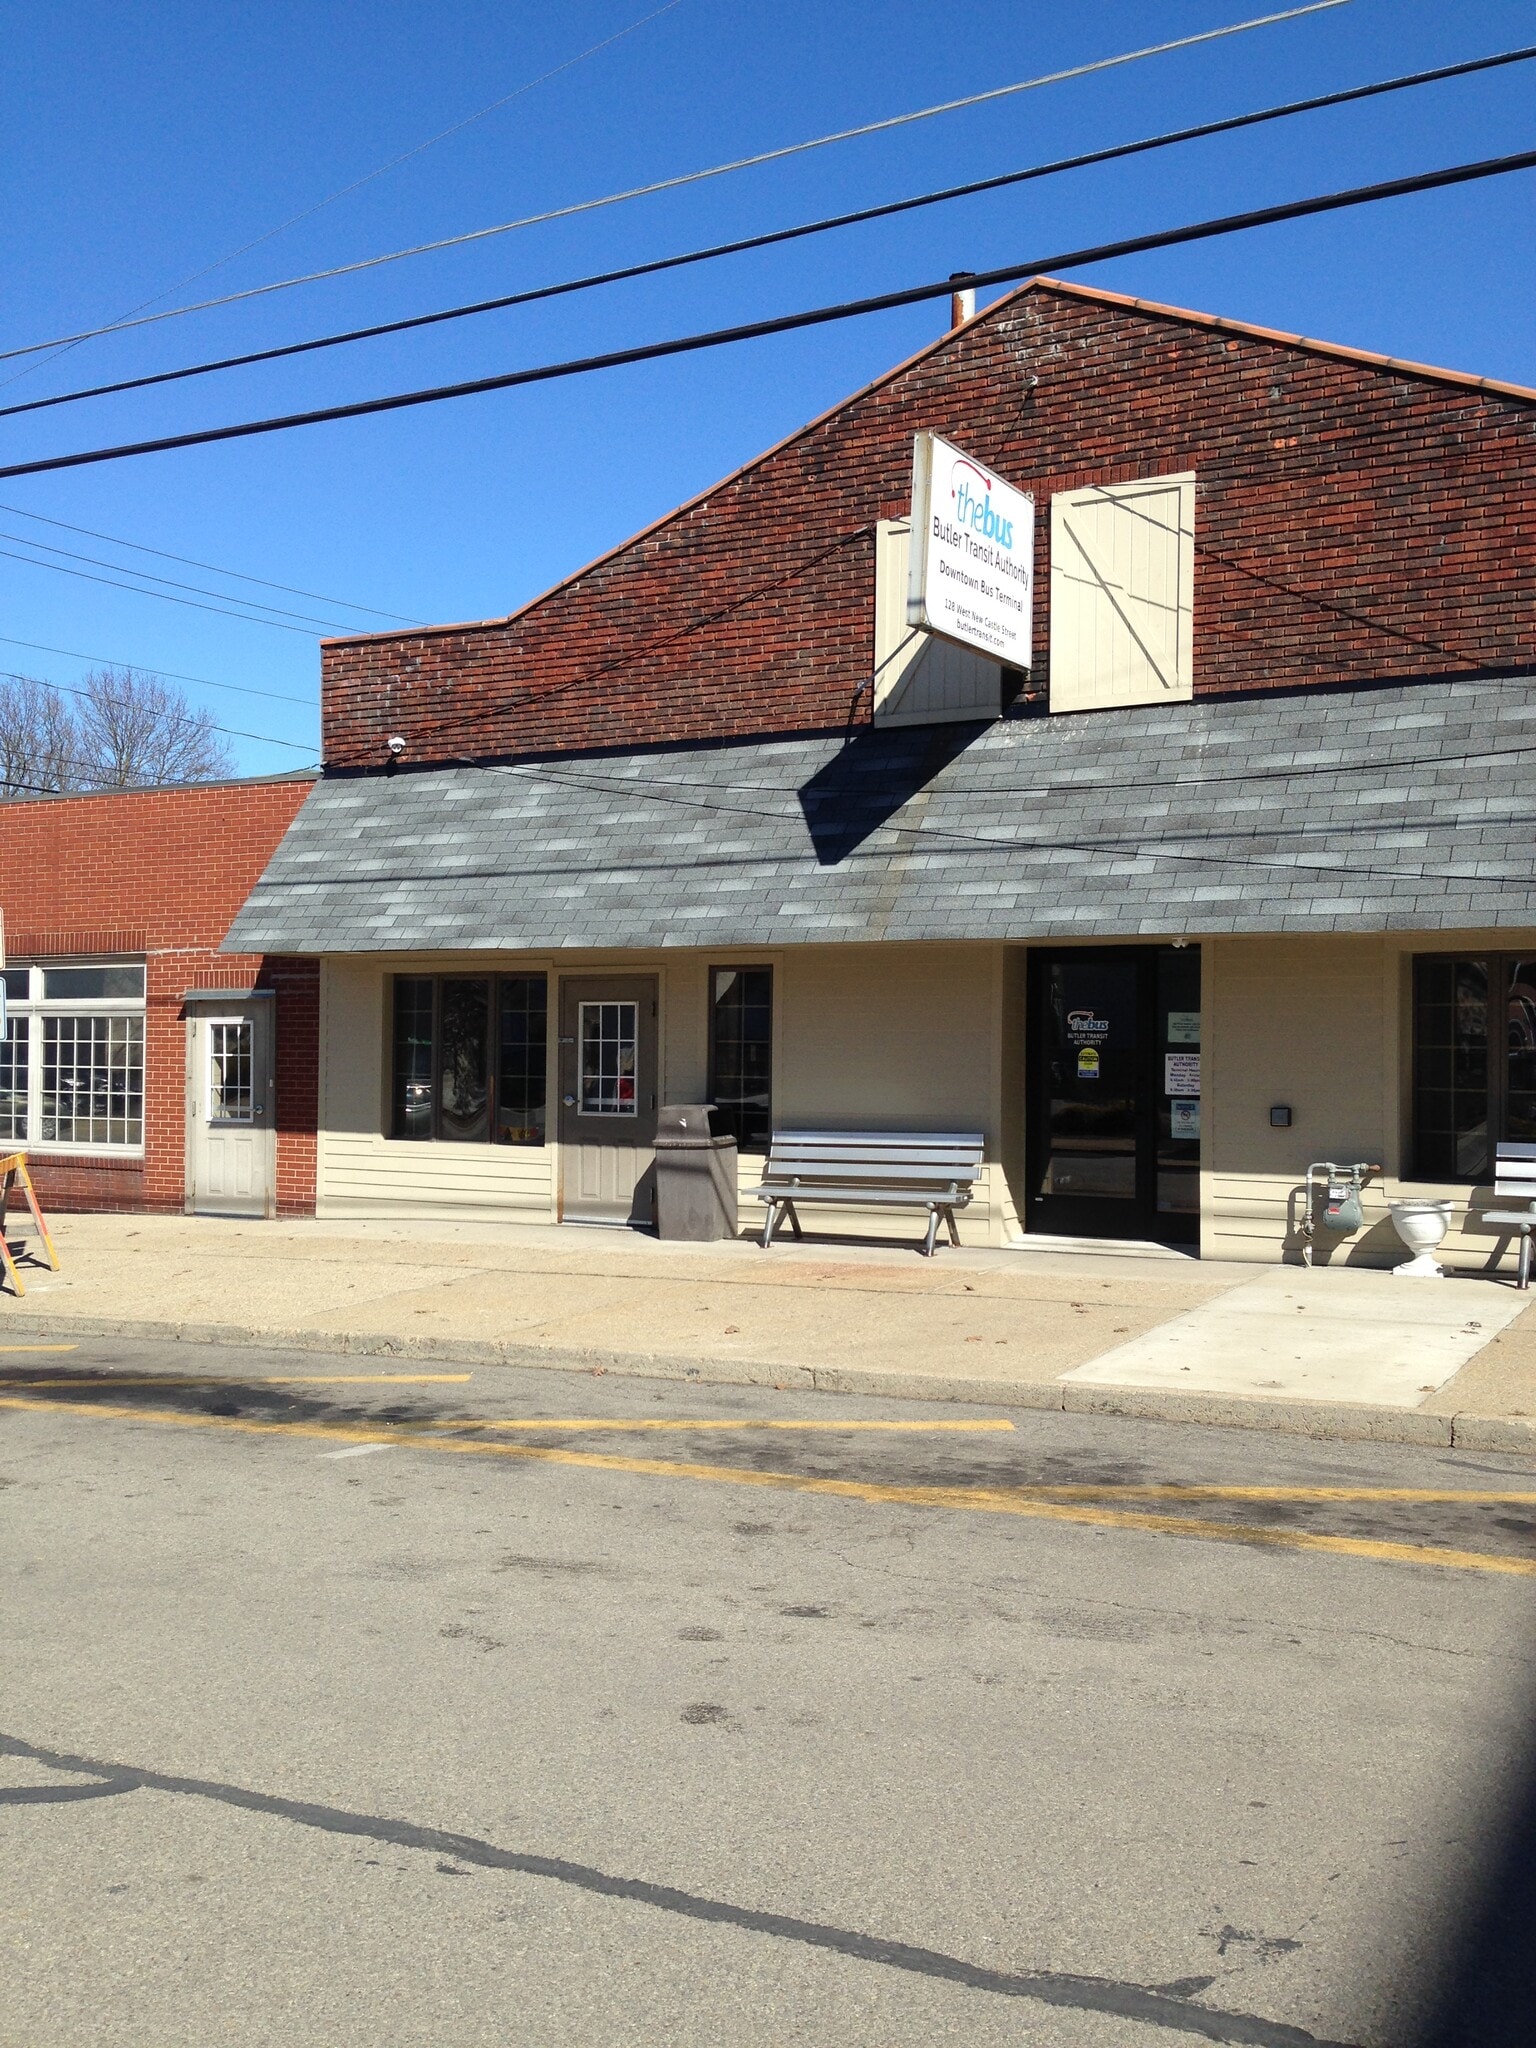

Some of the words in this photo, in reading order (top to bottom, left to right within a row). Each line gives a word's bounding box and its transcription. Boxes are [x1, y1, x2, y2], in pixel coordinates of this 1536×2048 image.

[933, 516, 962, 547] Butler
[964, 532, 994, 567] Transit
[995, 549, 1029, 591] Authority
[939, 559, 979, 591] Downtown
[980, 579, 994, 598] Bus
[995, 587, 1023, 613] Terminal
[944, 598, 957, 611] 128
[957, 603, 971, 620] West
[971, 612, 984, 624] New
[985, 615, 1000, 632] Castle
[1001, 624, 1017, 641] Street
[956, 618, 1005, 649] butlertransit.com
